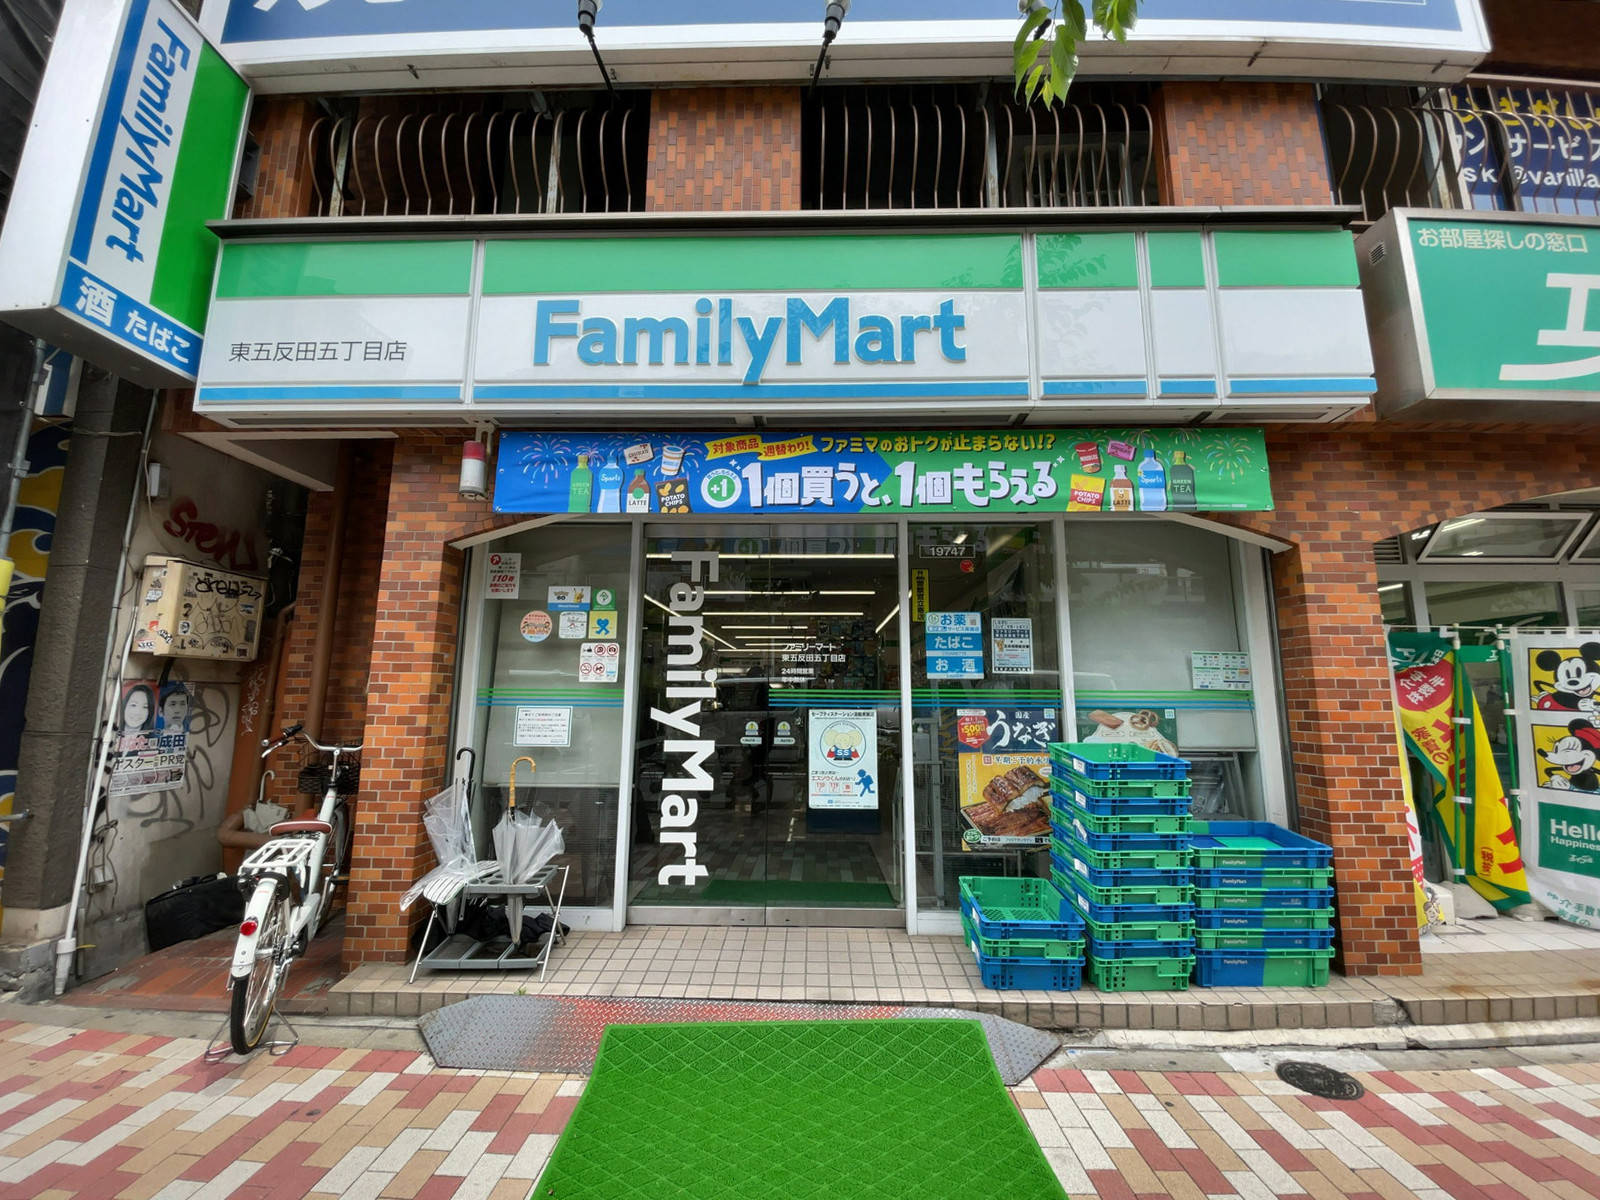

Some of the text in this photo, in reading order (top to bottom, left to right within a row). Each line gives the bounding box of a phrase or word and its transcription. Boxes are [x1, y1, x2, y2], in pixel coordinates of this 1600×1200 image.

[105, 17, 192, 263] FamilyMart
[1417, 227, 1588, 253] お部屋探しの窓口
[76, 276, 190, 363] 酒 たばこ
[533, 297, 967, 386] FamilyMart
[229, 340, 407, 362] 東五反田五丁目店
[712, 437, 760, 455] 対象商品
[601, 473, 620, 482] Sports
[1140, 475, 1162, 484] Sports
[1074, 490, 1100, 500] POTATO
[1173, 485, 1192, 493] TEA
[661, 493, 685, 502] POTATO
[665, 499, 683, 507] CHIPS
[1076, 496, 1097, 505] CHIPS
[930, 546, 966, 557] 19747
[940, 613, 967, 627] お薬
[782, 642, 837, 652] ファミリーマート
[934, 635, 974, 649] たばこ
[781, 653, 846, 663] 東五反田五丁目店
[935, 658, 976, 672] お酒
[650, 551, 720, 887] FamilyMart
[986, 709, 1056, 750] うなぎ
[159, 734, 186, 748] 成田
